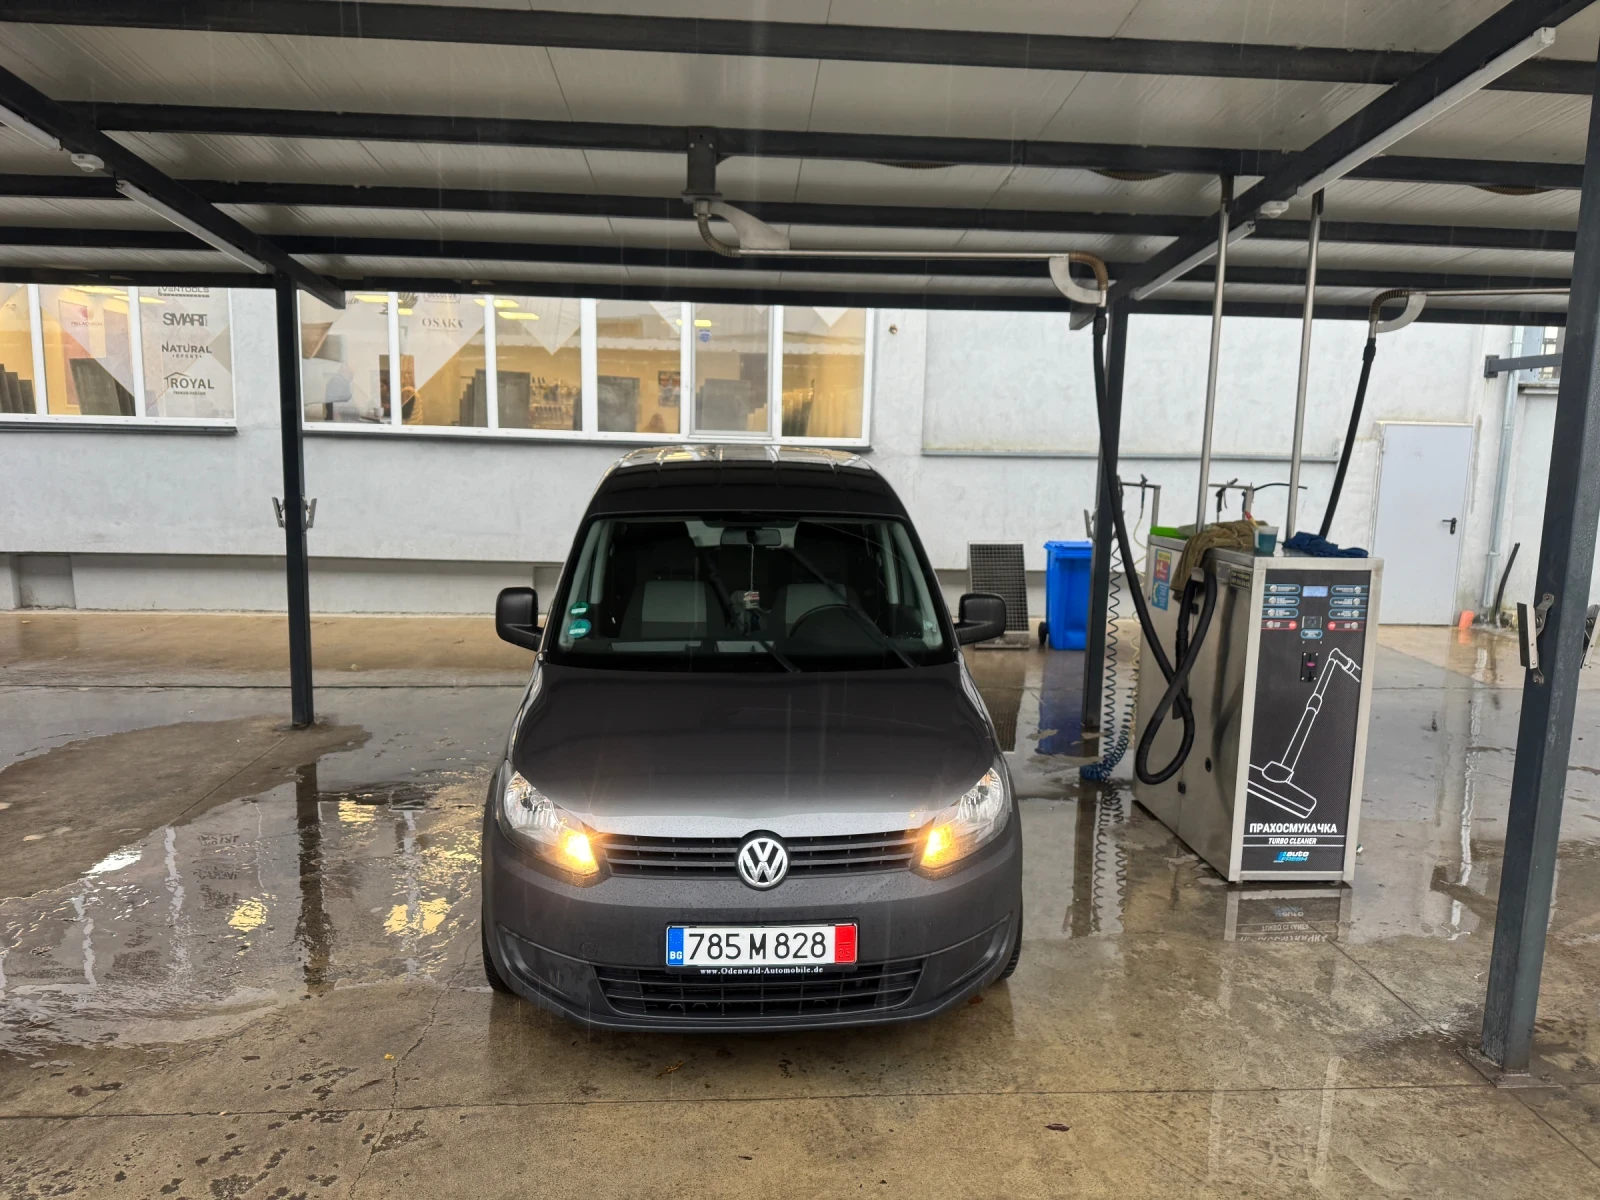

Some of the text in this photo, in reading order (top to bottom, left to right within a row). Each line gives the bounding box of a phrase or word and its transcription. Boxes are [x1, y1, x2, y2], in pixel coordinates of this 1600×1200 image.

[163, 312, 207, 327] SMART
[422, 317, 464, 329] OSAKA
[161, 341, 212, 354] NATURAL
[170, 377, 215, 390] ROYAL
[1249, 823, 1338, 834] ПРАХОСМУКАЧКА
[1268, 837, 1318, 845] TURBO CLEANER
[688, 931, 827, 960] 785 M 828
[669, 951, 683, 960] BG
[700, 966, 824, 975] www.Odenwald-Automobile.de
